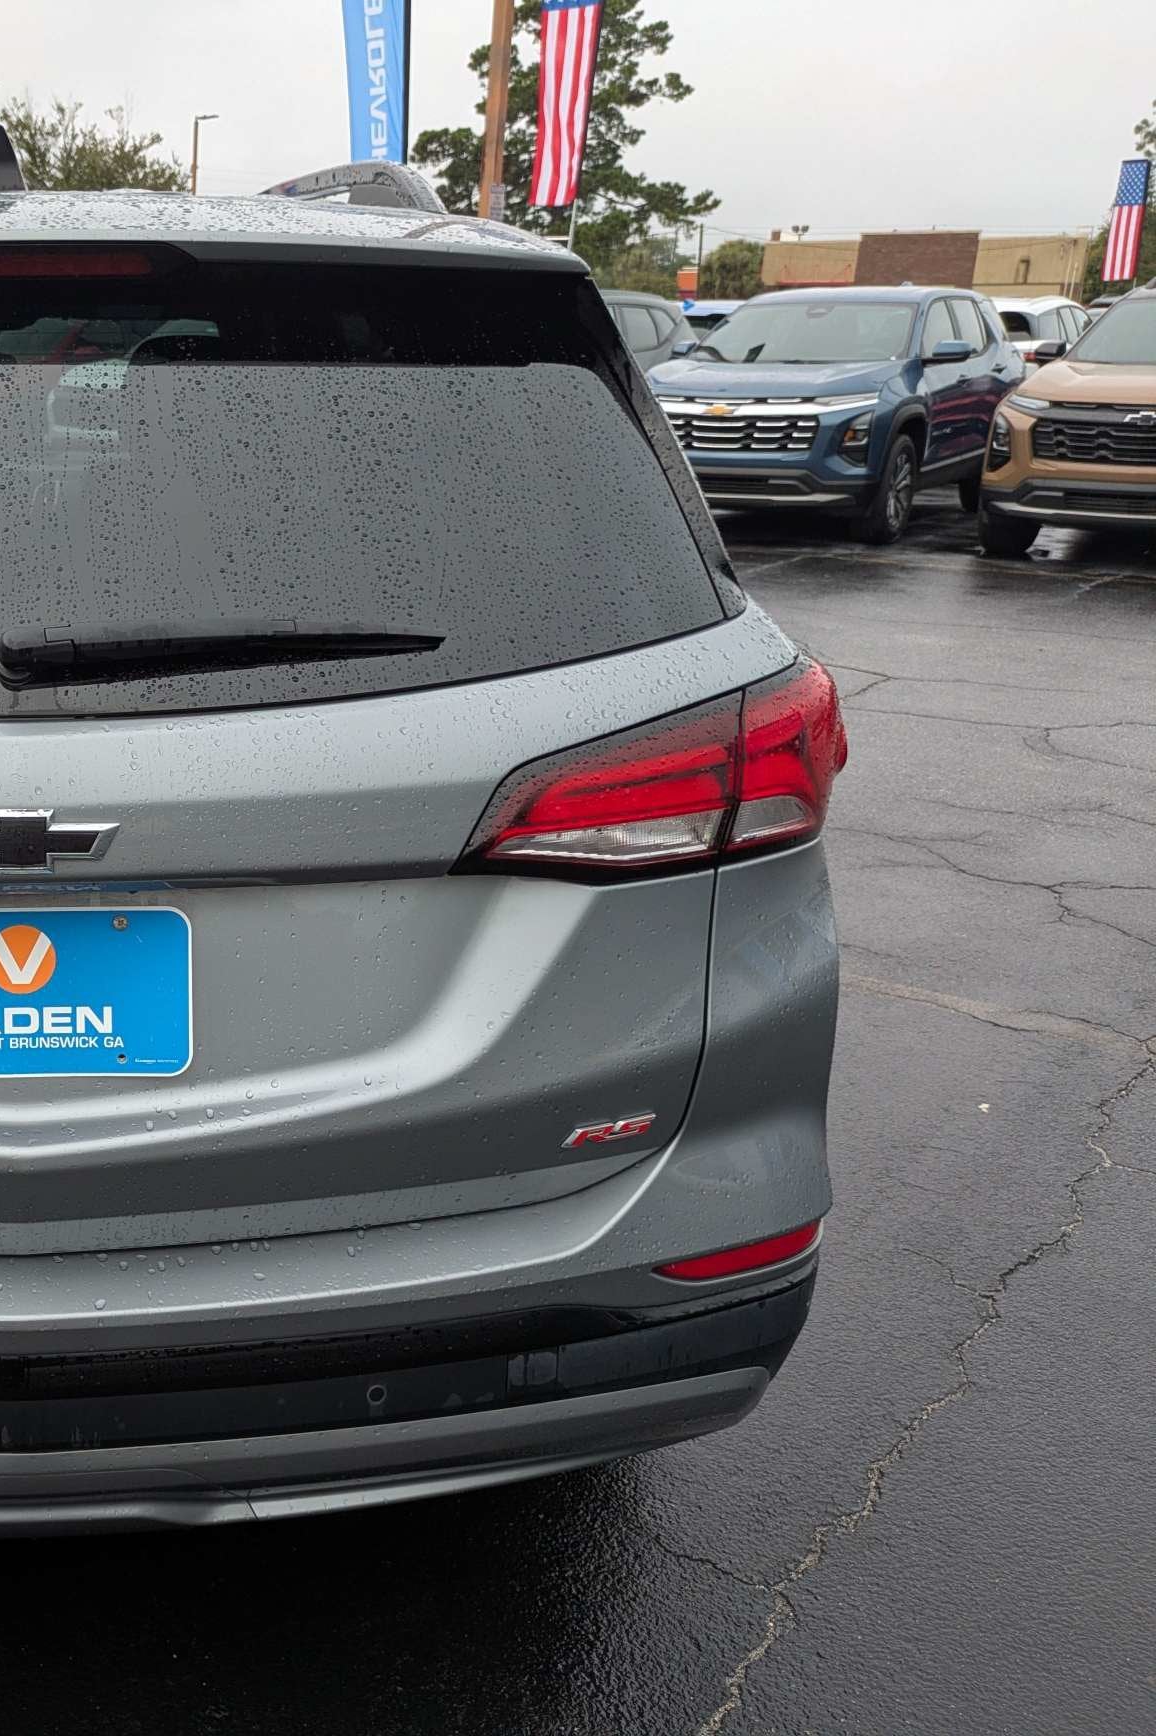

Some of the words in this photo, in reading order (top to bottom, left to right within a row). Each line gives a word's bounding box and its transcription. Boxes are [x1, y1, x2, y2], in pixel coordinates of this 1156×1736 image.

[9, 1036, 99, 1050] BRUNSWICK
[103, 1035, 125, 1049] GA
[561, 1113, 656, 1148] RS
